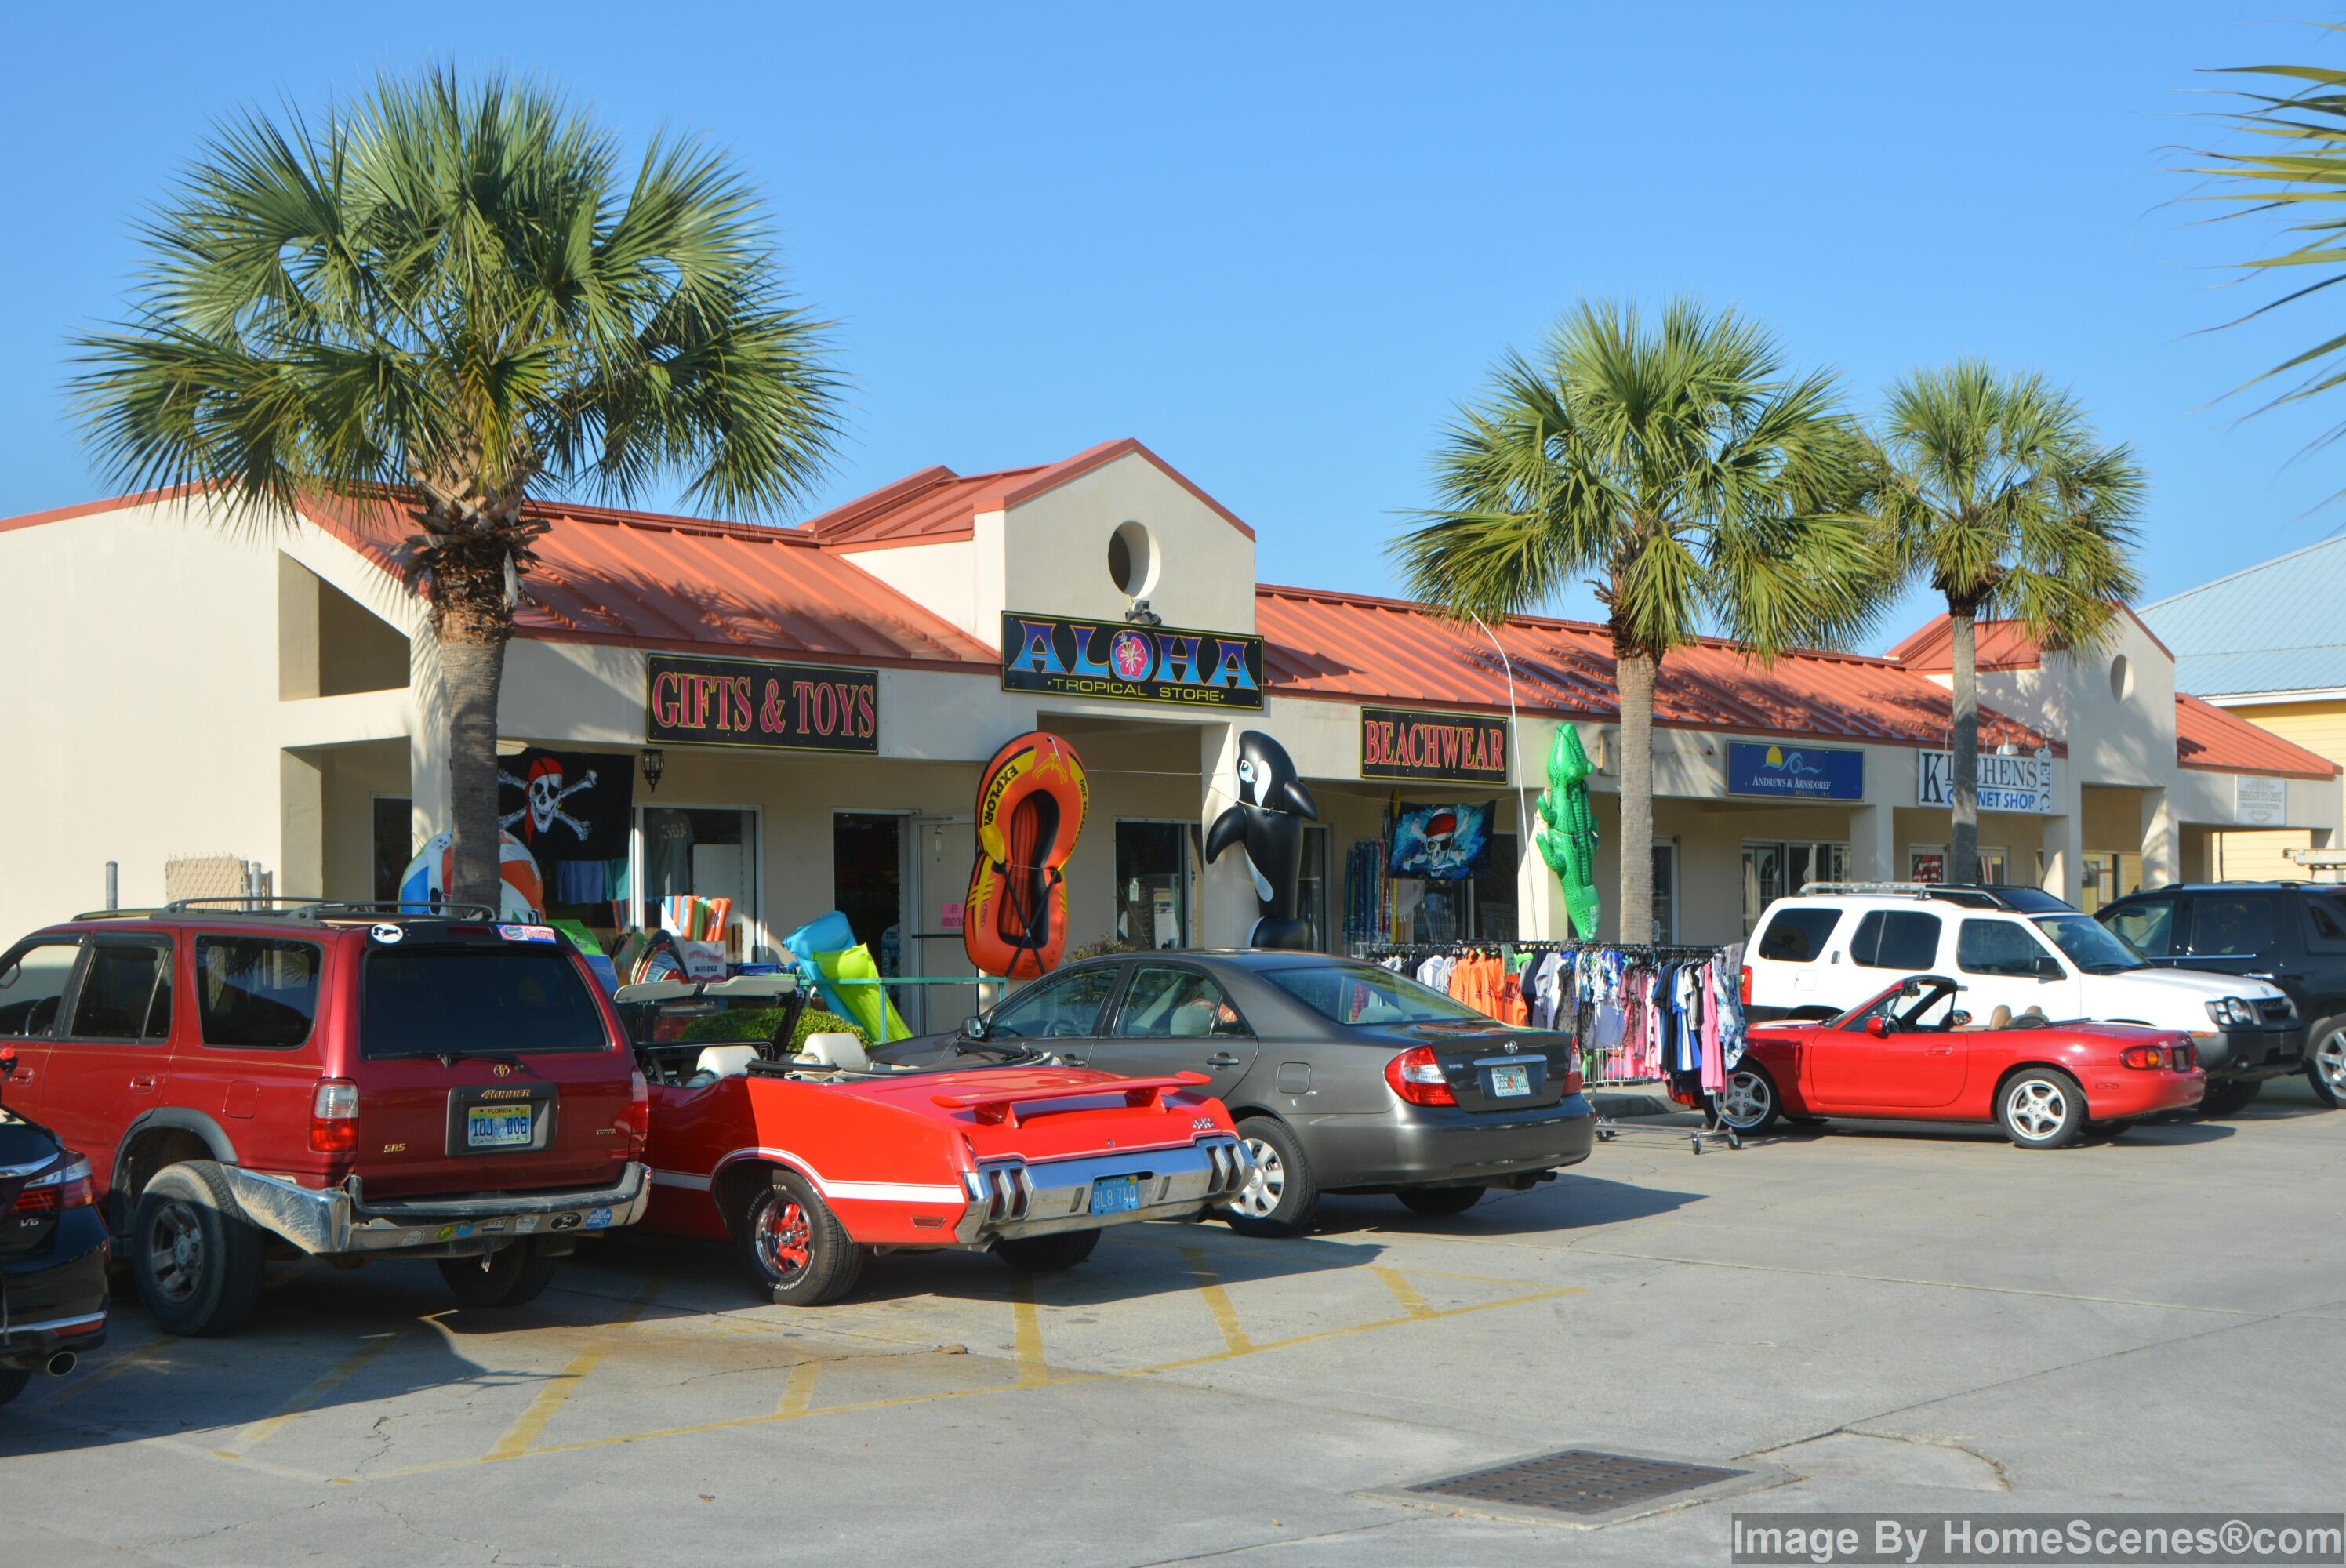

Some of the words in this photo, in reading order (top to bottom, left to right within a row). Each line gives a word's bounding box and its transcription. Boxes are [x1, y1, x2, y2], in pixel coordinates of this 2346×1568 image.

[1008, 620, 1259, 690] ALOHA
[652, 671, 753, 732] GIFTS
[760, 677, 786, 734] &
[792, 681, 875, 739] TOYS
[1052, 677, 1148, 697] TROPICAL
[1160, 687, 1220, 702] STORE
[1364, 720, 1505, 771] BEACHWEAR
[1786, 778, 1793, 789] &
[1920, 752, 2038, 804] KIHENS
[1947, 789, 2002, 808] CNET
[2003, 793, 2036, 810] SHOP
[20, 1217, 40, 1228] V6
